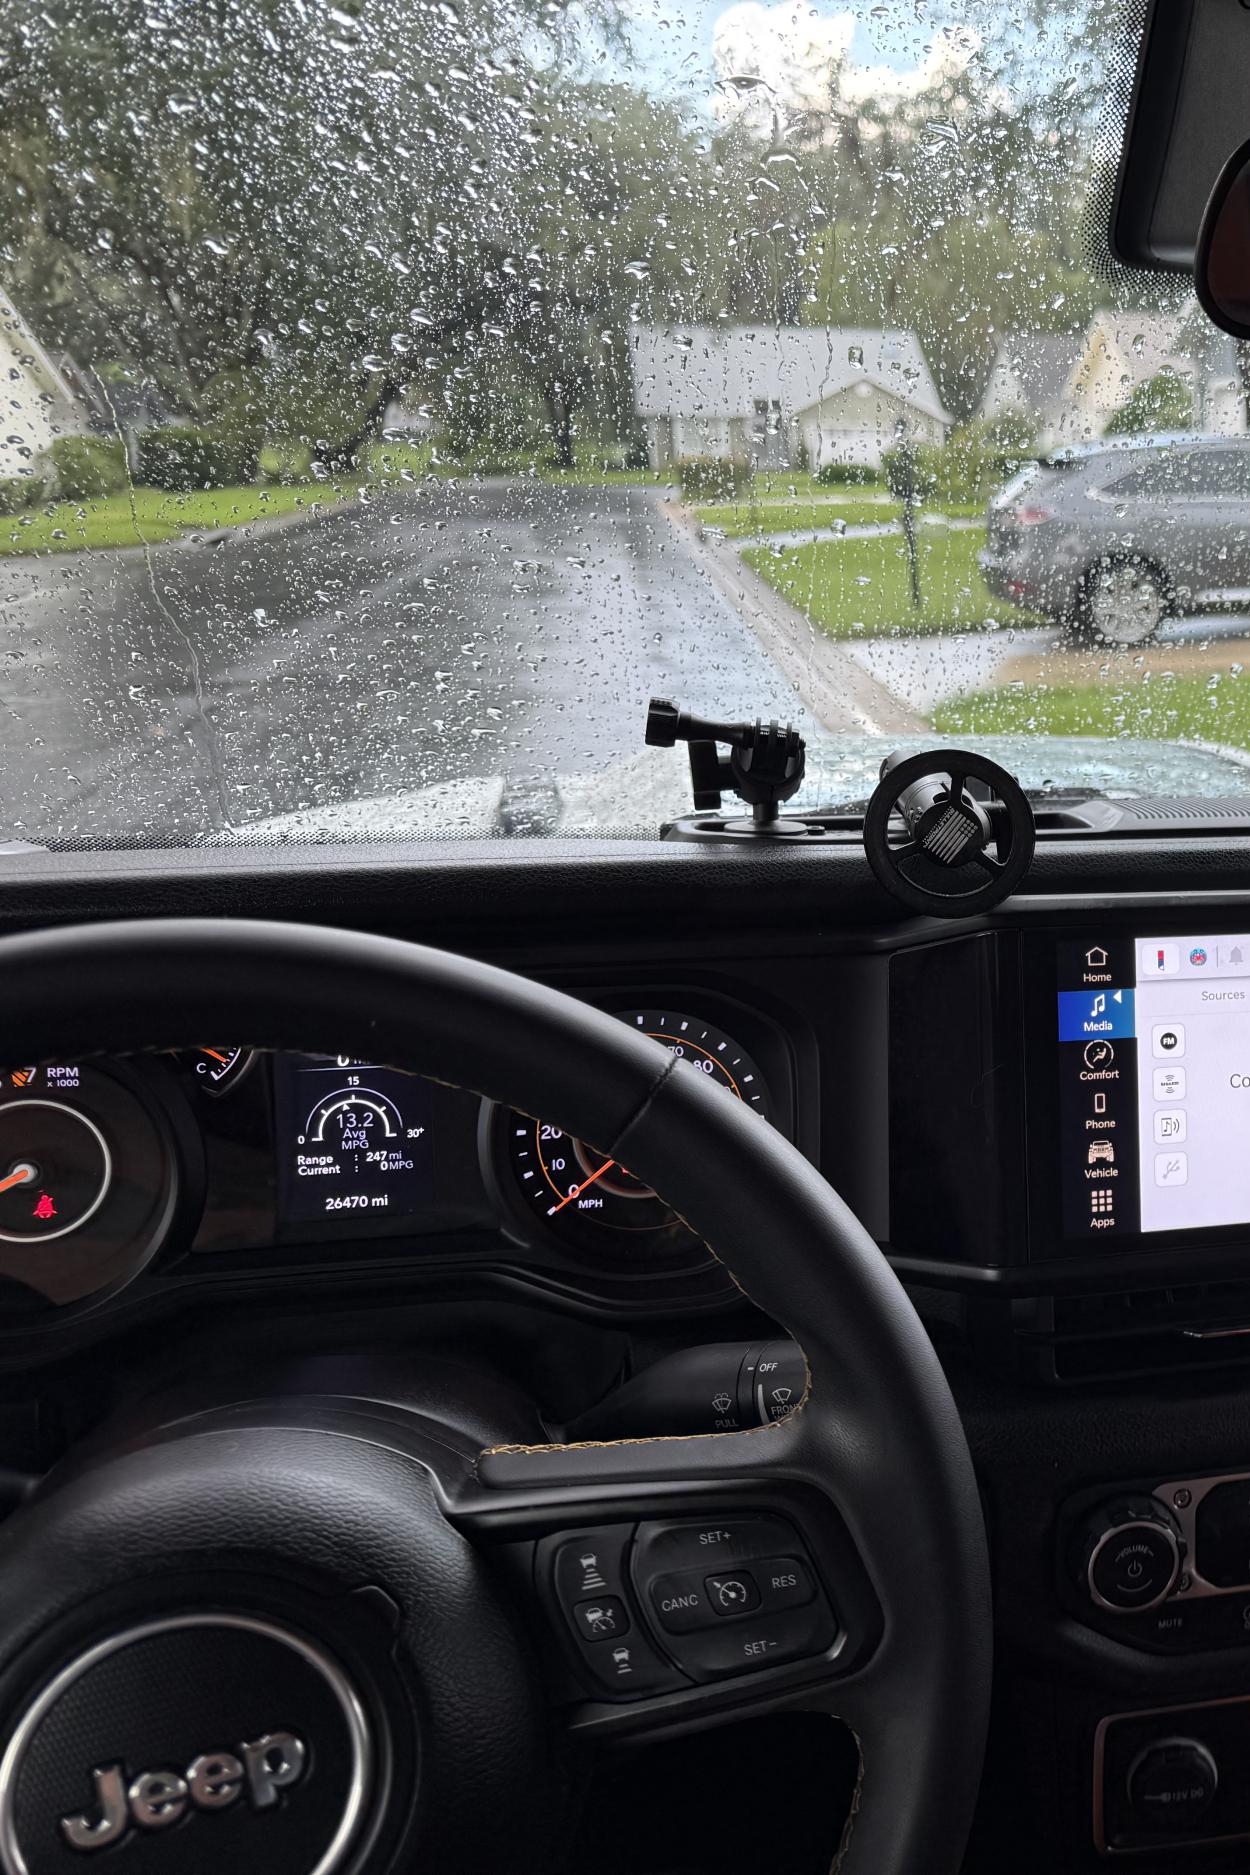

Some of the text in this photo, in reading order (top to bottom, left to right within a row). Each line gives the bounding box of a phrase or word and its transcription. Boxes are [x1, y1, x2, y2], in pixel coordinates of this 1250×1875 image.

[1083, 972, 1112, 983] Home
[1201, 989, 1245, 1001] Sources
[1083, 1020, 1113, 1032] Media
[47, 1067, 79, 1078] RPM
[196, 1062, 207, 1074] C
[347, 1076, 360, 1086] 15
[1079, 1069, 1119, 1081] Comfort
[56, 1079, 79, 1087] 1000
[336, 1112, 374, 1128] 13.2
[1085, 1119, 1116, 1130] Phone
[342, 1128, 366, 1140] Avg
[540, 1125, 562, 1140] 20
[297, 1136, 305, 1145] 0
[341, 1139, 369, 1150] MPG
[297, 1150, 402, 1166] Range 247 mi
[298, 1160, 414, 1176] Current 0 MPG
[552, 1158, 566, 1171] 10
[1084, 1167, 1119, 1178] Vehicle
[568, 1184, 580, 1199] 0
[325, 1194, 388, 1210] 26470 mi
[578, 1198, 603, 1209] MPH
[1090, 1217, 1115, 1228] Apps
[759, 1362, 778, 1372] OFF
[715, 1418, 739, 1429] PULL
[699, 1531, 732, 1546] SET+
[1120, 1544, 1150, 1559] VOLUME
[771, 1574, 797, 1589] RES
[661, 1594, 699, 1612] CANC
[1158, 1617, 1183, 1629] MUTE
[61, 1731, 304, 1847] Jeep
